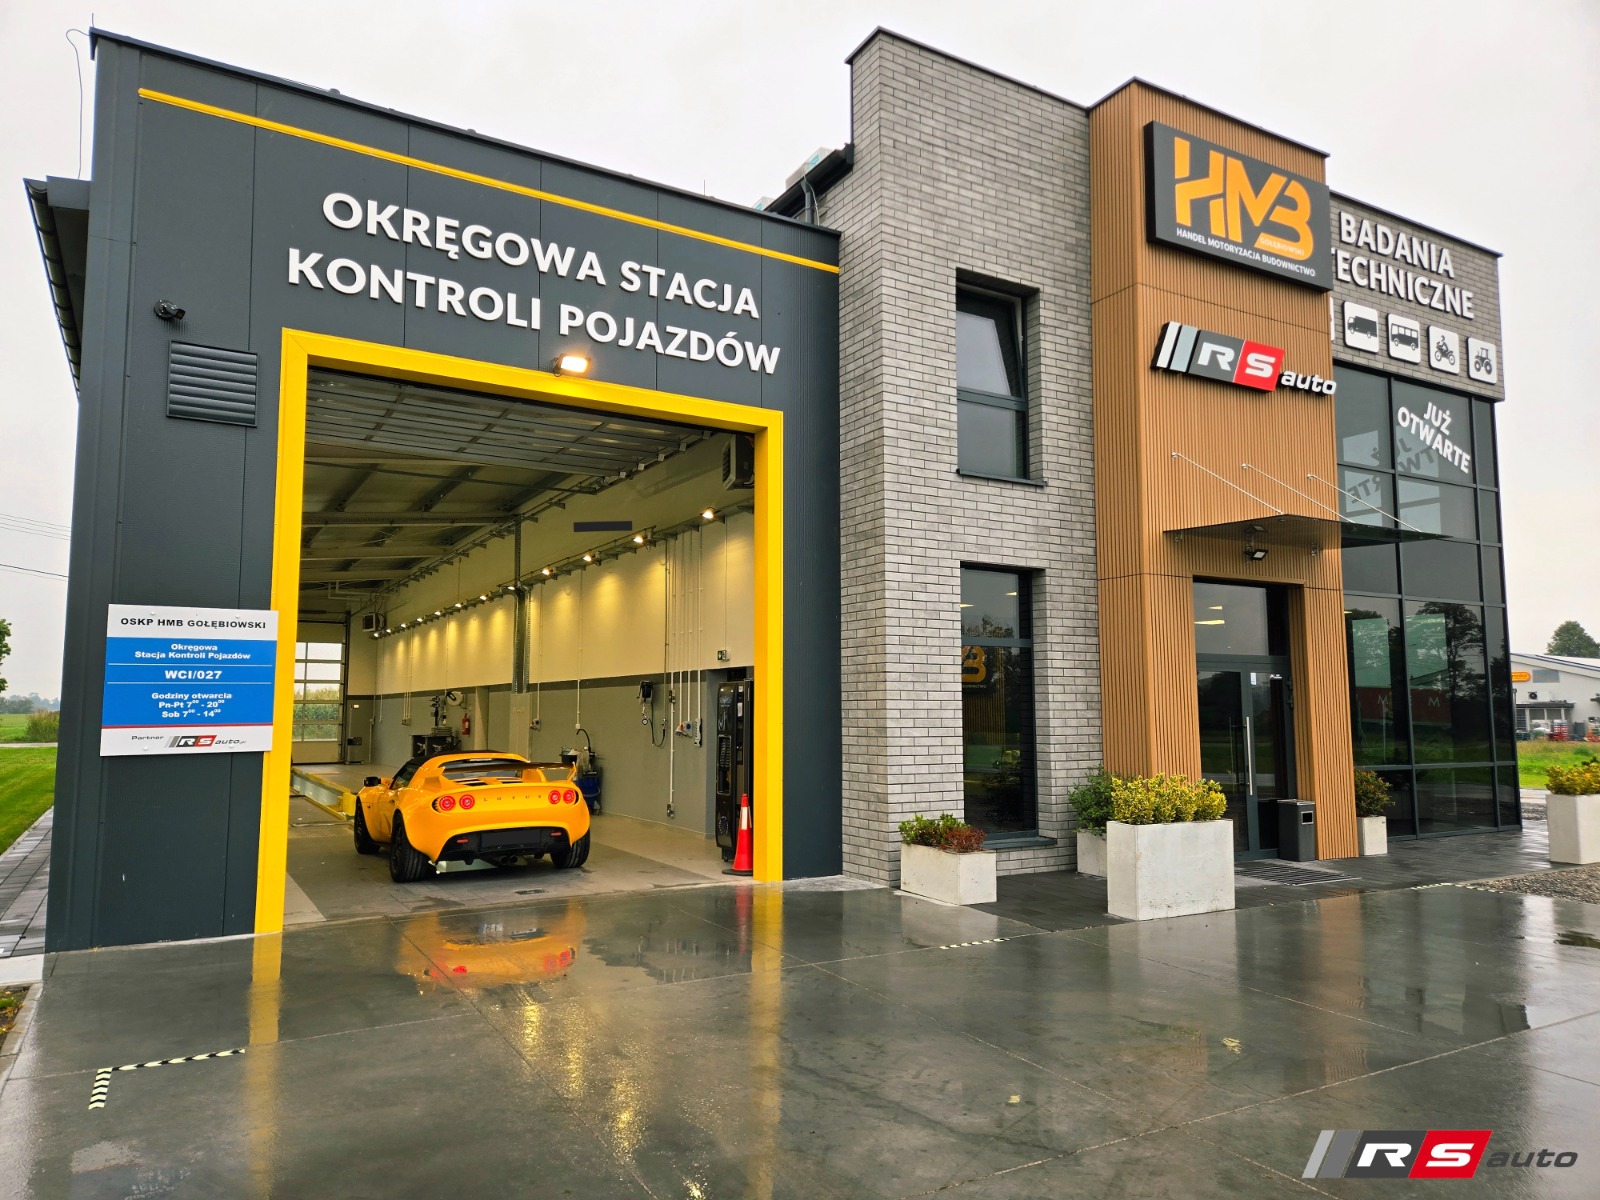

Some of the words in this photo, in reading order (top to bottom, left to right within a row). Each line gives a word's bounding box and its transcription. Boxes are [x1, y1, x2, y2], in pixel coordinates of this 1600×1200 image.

[1174, 136, 1314, 261] HMB
[322, 192, 606, 285] OKRĘGOWA
[620, 261, 760, 319] STACJA
[1176, 227, 1207, 245] HANDEL
[1208, 238, 1261, 261] MOTORYZACJA
[1262, 254, 1316, 277] BUDOWNICTWO
[1339, 211, 1454, 278] BADANIA
[288, 248, 541, 331] KONTROLI
[559, 303, 780, 375] POJAZDÓW
[1197, 342, 1277, 378] RS
[1281, 371, 1337, 396] auto
[1423, 401, 1453, 435] JUŻ
[1397, 406, 1471, 474] OTWARTE
[120, 617, 154, 626] OSKP
[157, 618, 184, 627] HMB
[187, 619, 266, 629] GOŁĘBIOWSKI
[134, 651, 166, 659] Stacja
[168, 651, 206, 659] Kontroli
[208, 651, 251, 660] Pojazdów
[170, 643, 218, 652] Okręgowa
[164, 670, 222, 680] WCI/027
[151, 692, 190, 700] Godziny
[161, 710, 180, 718] Sob
[178, 737, 213, 747] RS
